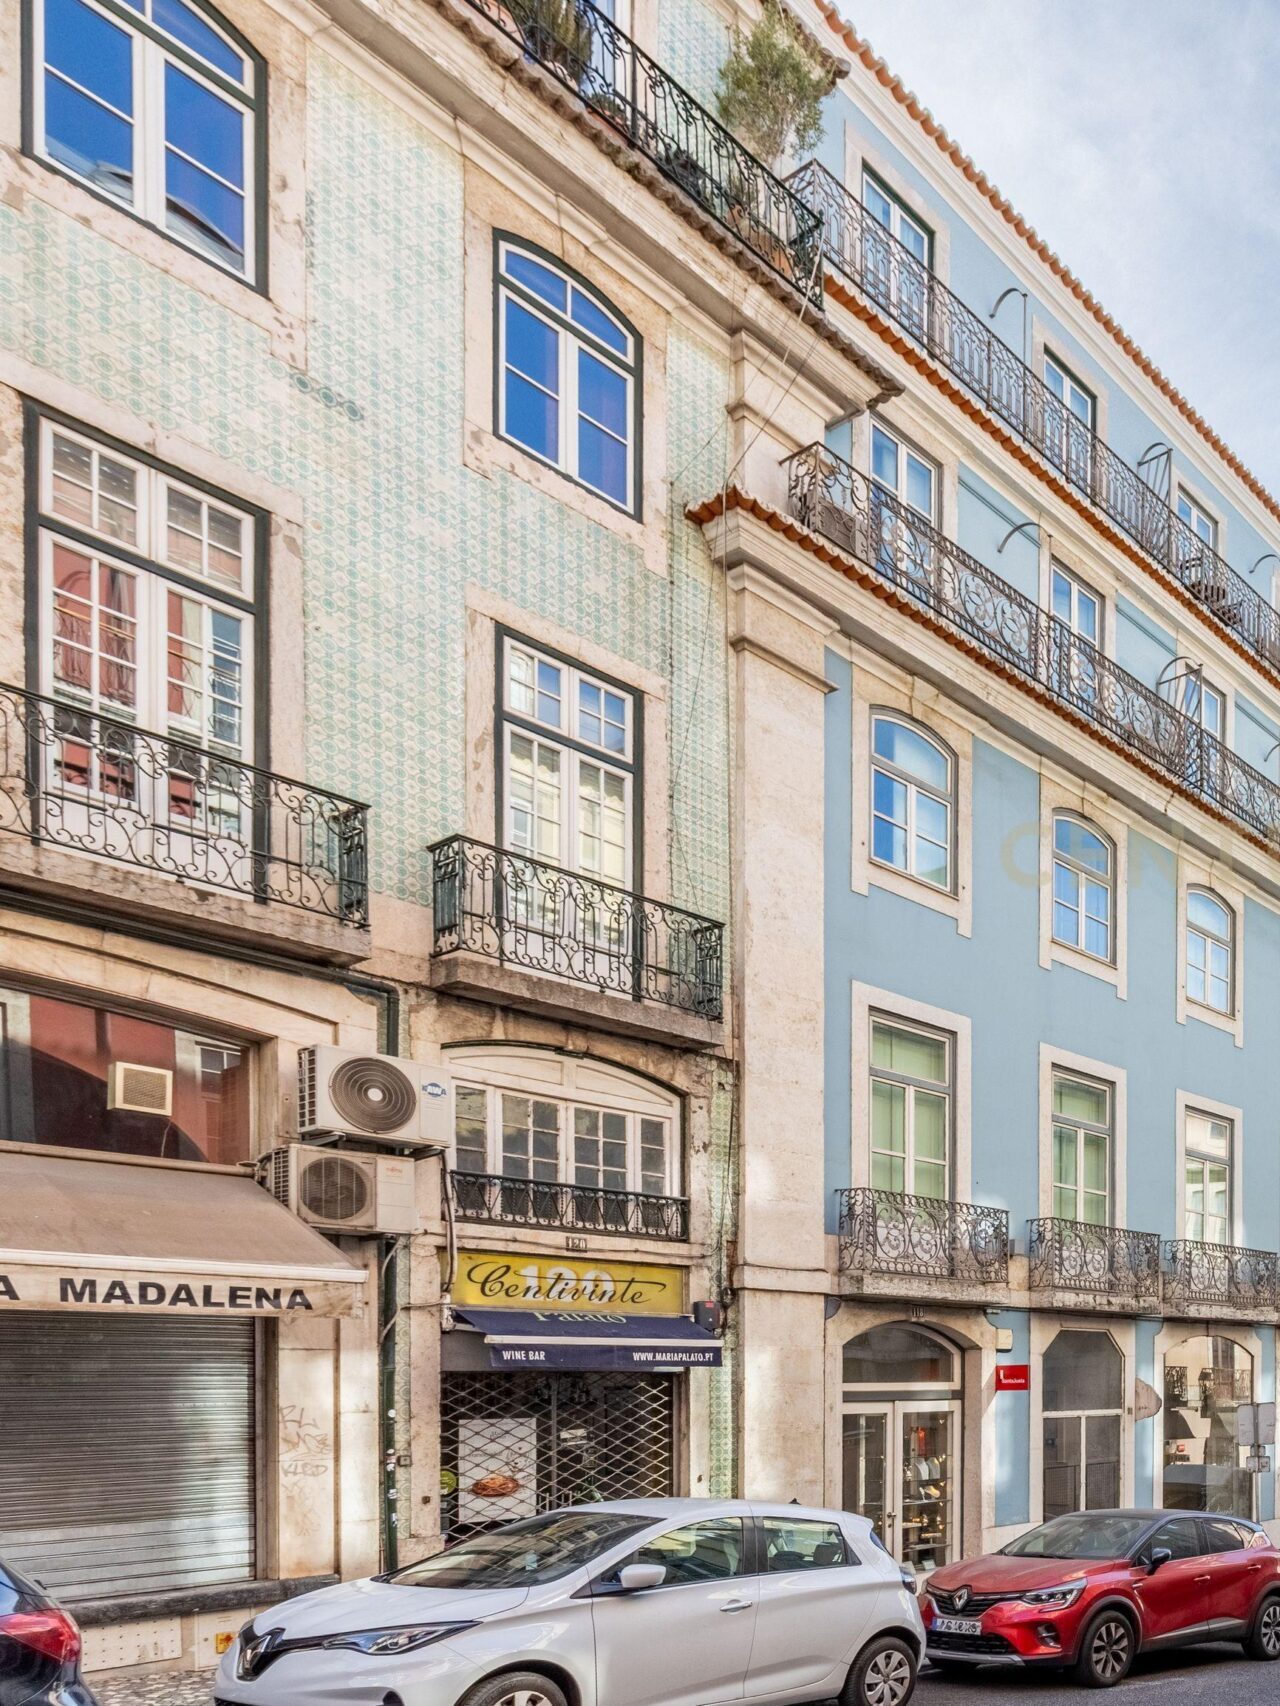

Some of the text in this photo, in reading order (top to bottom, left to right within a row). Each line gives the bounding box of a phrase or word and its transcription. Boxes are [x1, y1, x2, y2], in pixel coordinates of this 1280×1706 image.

[568, 1238, 586, 1250] 120
[466, 1261, 667, 1304] Centivinte
[59, 1277, 314, 1311] MADALENA
[502, 1350, 546, 1361] WINE BAR
[633, 1352, 714, 1362] WWW.MARIAPALATO.PT
